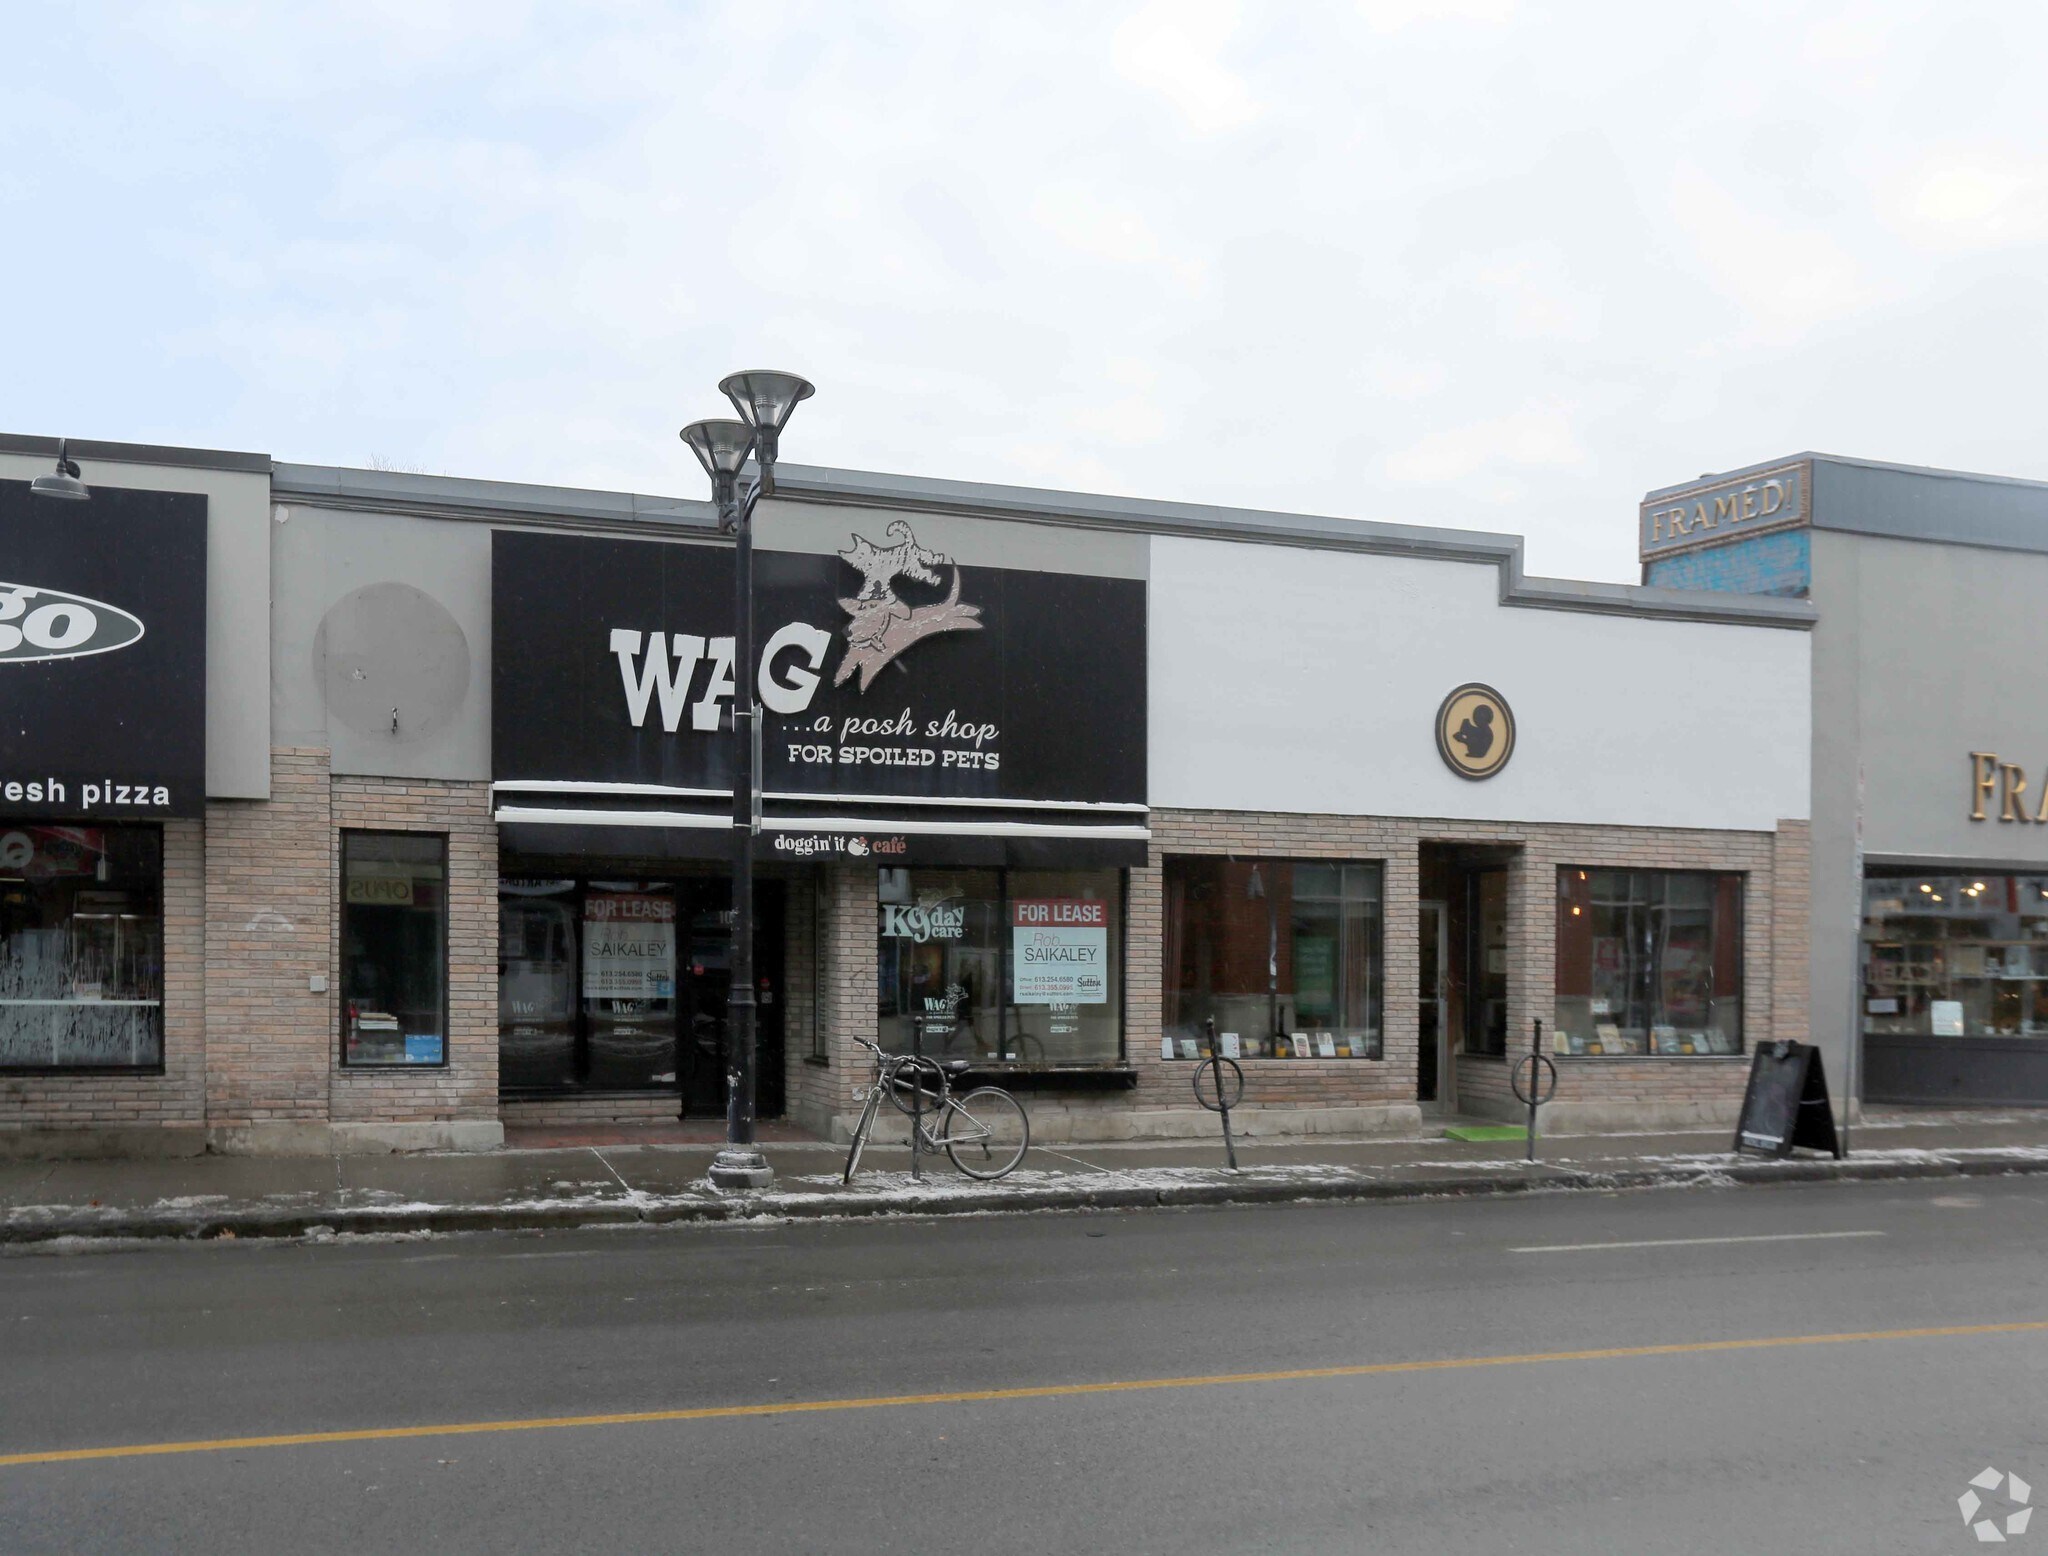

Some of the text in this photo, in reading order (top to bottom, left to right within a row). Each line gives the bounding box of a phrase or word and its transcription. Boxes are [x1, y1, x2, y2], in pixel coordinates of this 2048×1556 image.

[1651, 479, 1793, 542] FRAMED!
[610, 621, 832, 732] WAG
[840, 706, 917, 744] posh
[925, 709, 999, 749] shop
[787, 744, 1000, 770] FOR SPOILED PETS
[82, 779, 170, 809] pizza
[834, 835, 846, 852] it
[872, 836, 907, 854] café
[585, 899, 673, 918] FOR LEASE
[1018, 904, 1102, 922] FOR LEASE
[882, 904, 965, 943] K9 day
[931, 926, 963, 938] care
[1033, 931, 1060, 947] Rob
[591, 942, 667, 957] SAIKALEY
[1024, 947, 1097, 961] SAIKALEY
[1077, 976, 1101, 988] Sutton
[511, 1000, 535, 1014] WAG
[611, 1000, 634, 1014] WAG
[924, 997, 947, 1011] WAG
